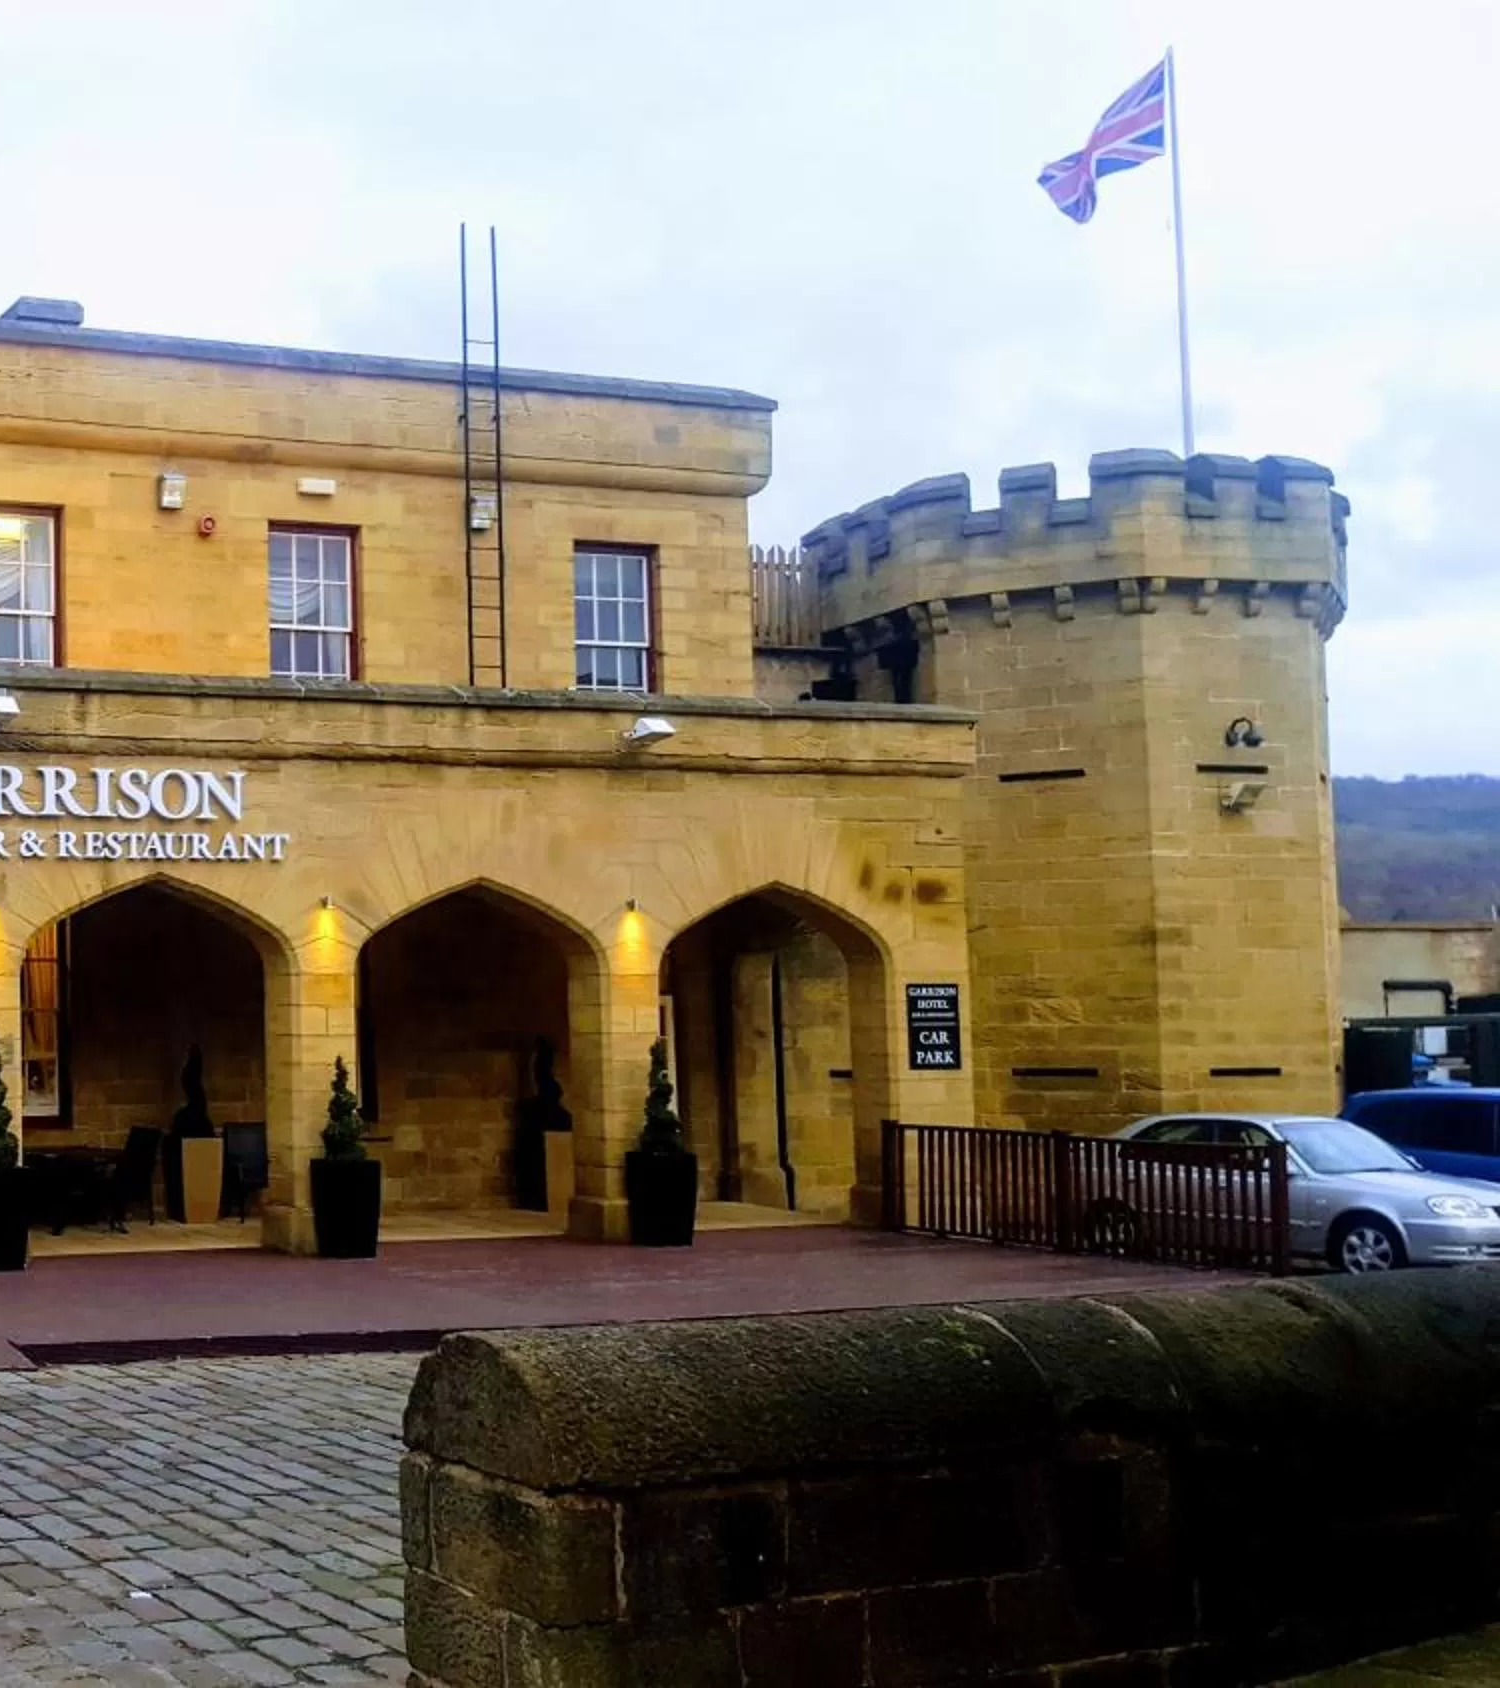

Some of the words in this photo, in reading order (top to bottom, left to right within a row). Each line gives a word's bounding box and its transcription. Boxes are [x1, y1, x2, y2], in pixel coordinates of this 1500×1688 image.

[19, 830, 48, 857] &
[57, 831, 291, 861] RESTAURANT
[917, 999, 949, 1009] HOTEL
[919, 1031, 949, 1044] CAR
[916, 1051, 954, 1065] PARK
